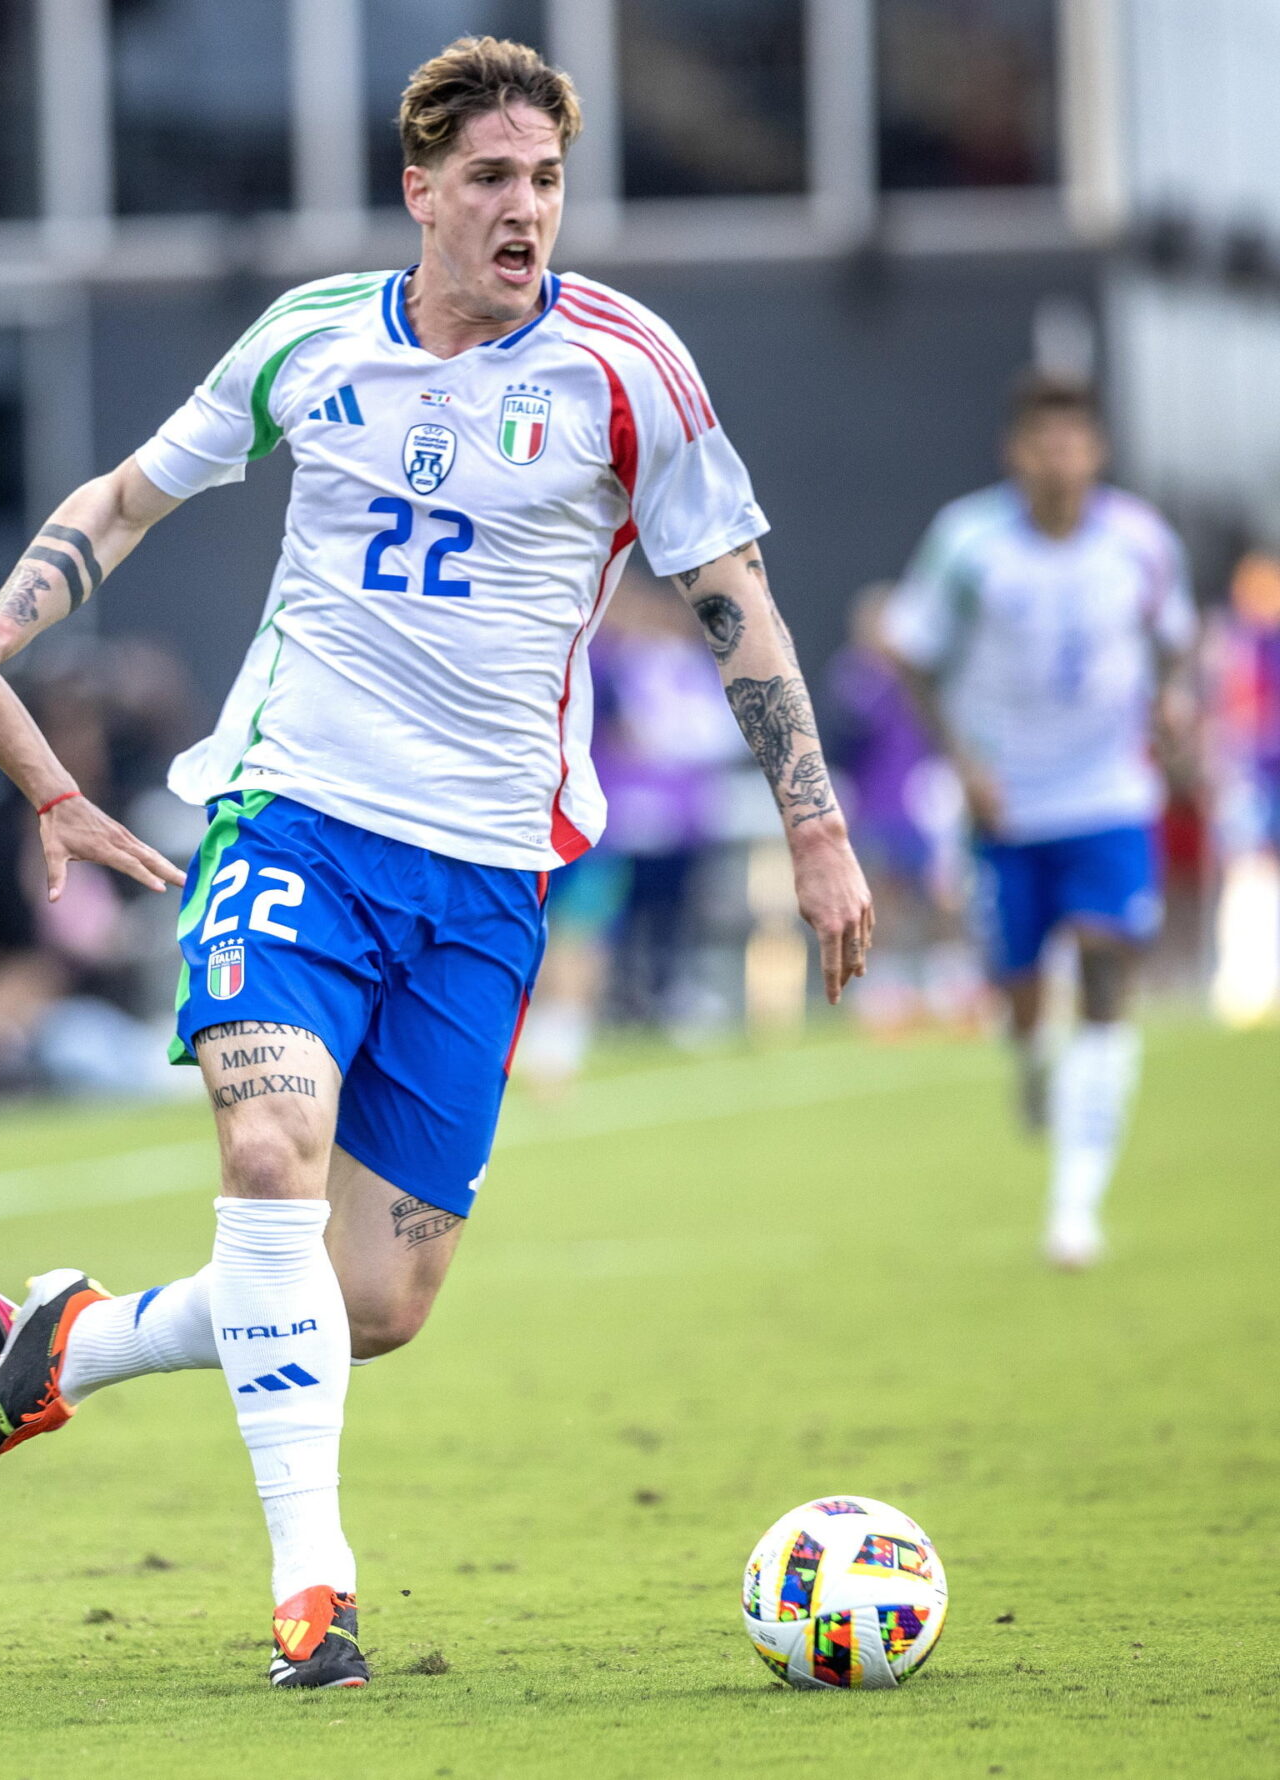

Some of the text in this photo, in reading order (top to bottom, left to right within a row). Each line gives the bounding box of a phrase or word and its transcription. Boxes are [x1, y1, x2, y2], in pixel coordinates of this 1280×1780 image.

[506, 400, 545, 415] ITALIA
[362, 496, 473, 597] 22
[199, 859, 306, 944] 22
[211, 949, 241, 966] ITALIA
[221, 1046, 285, 1070] MMIV
[213, 1074, 317, 1111] MCMLXXIII
[222, 1319, 317, 1341] ITALIA
